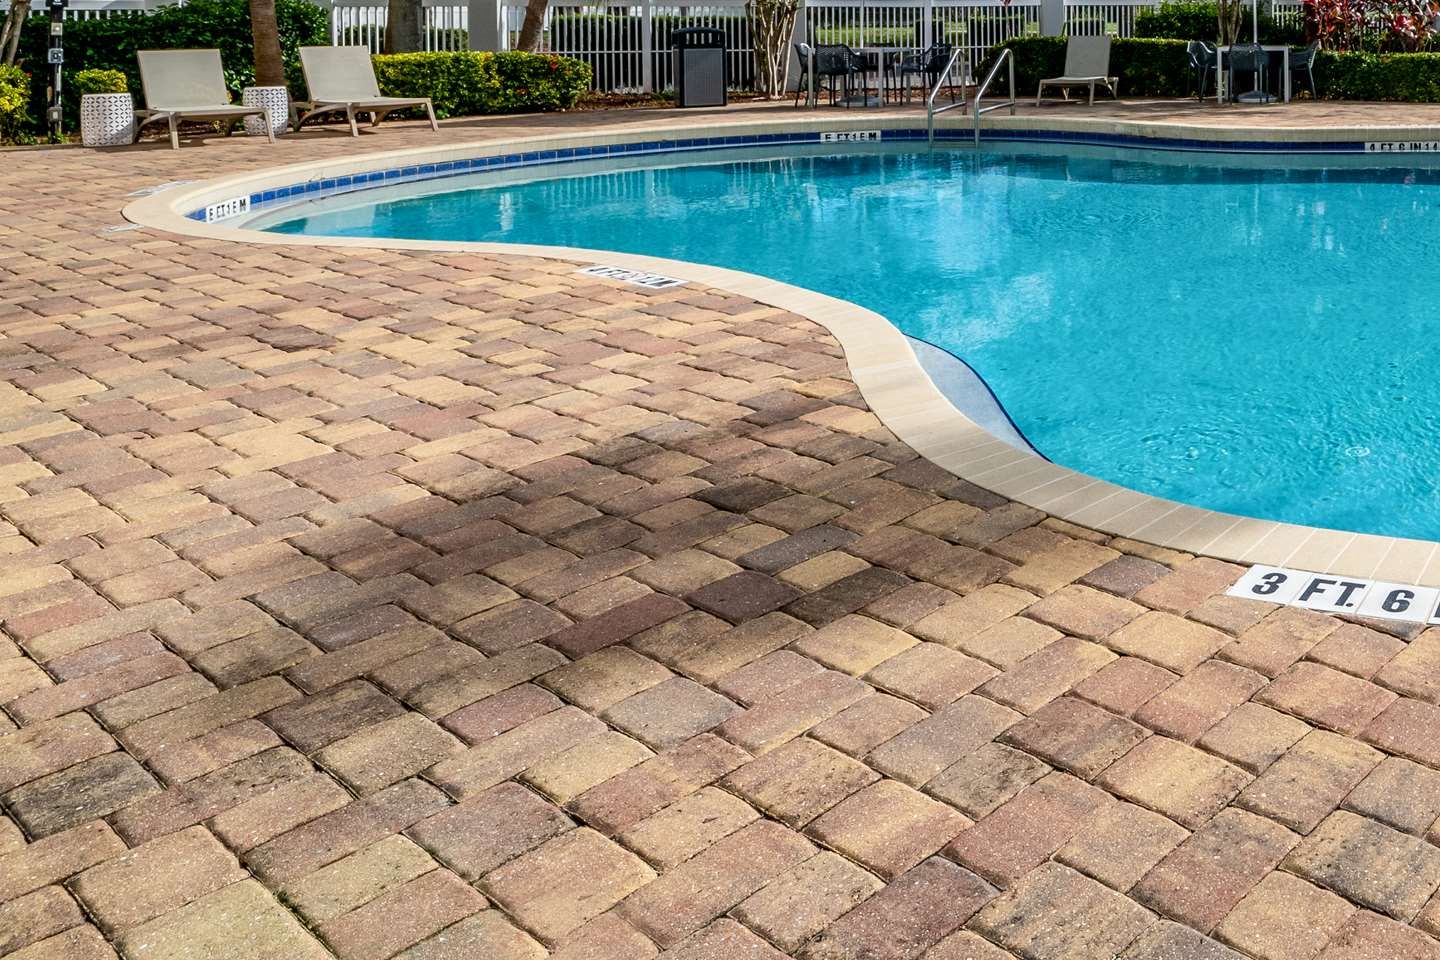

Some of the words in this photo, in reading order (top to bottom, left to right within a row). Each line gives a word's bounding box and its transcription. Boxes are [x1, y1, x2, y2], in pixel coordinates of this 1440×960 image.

[1410, 142, 1421, 150] IN
[1251, 572, 1288, 595] 3
[1298, 578, 1367, 607] FT.
[1381, 589, 1416, 613] 6
